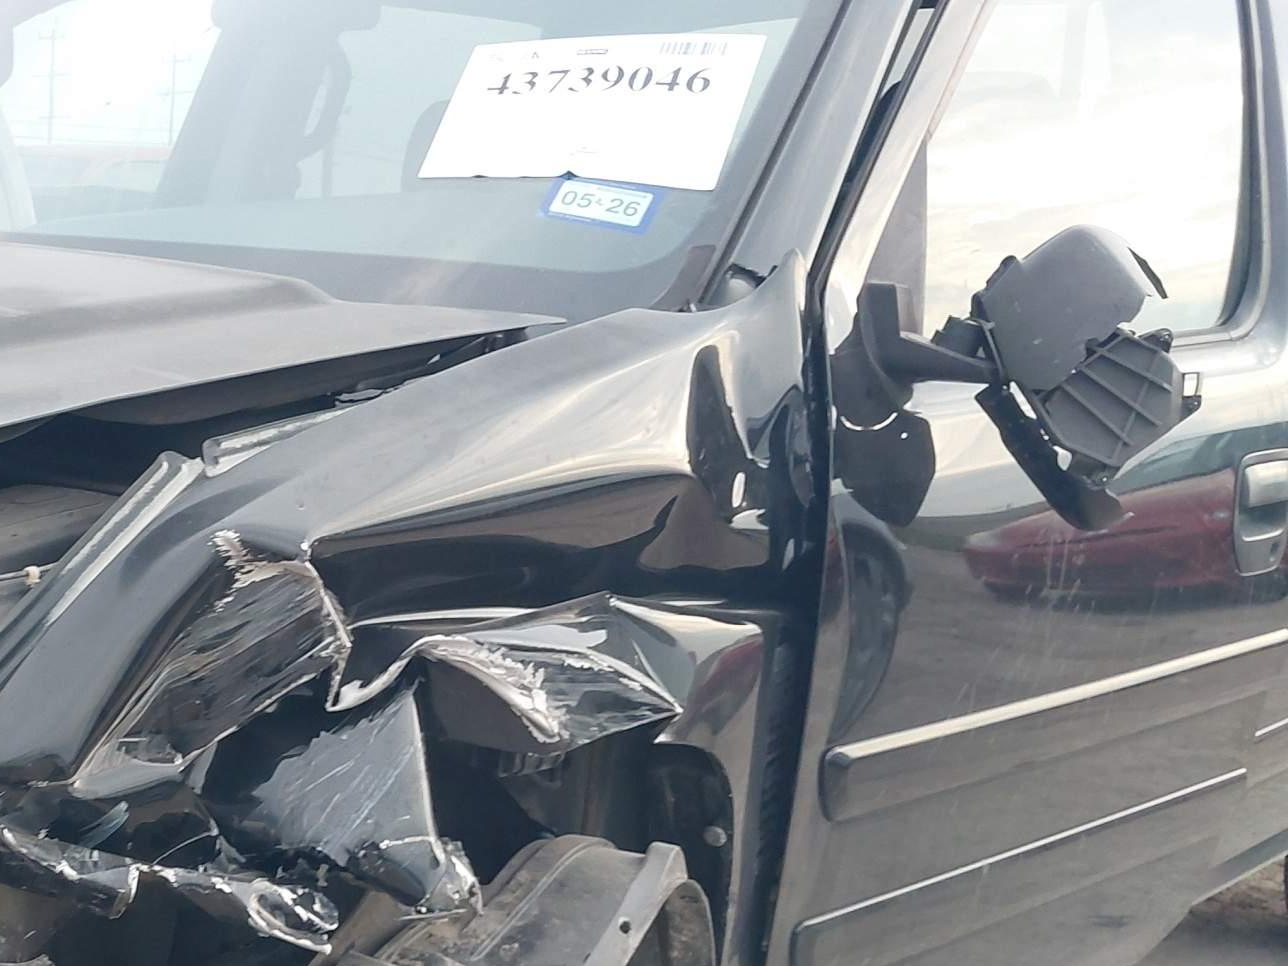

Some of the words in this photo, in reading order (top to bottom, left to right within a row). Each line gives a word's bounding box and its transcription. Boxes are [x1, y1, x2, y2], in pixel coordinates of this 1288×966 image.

[487, 66, 711, 95] 43739046
[561, 190, 596, 208] 05
[605, 198, 641, 217] 26
